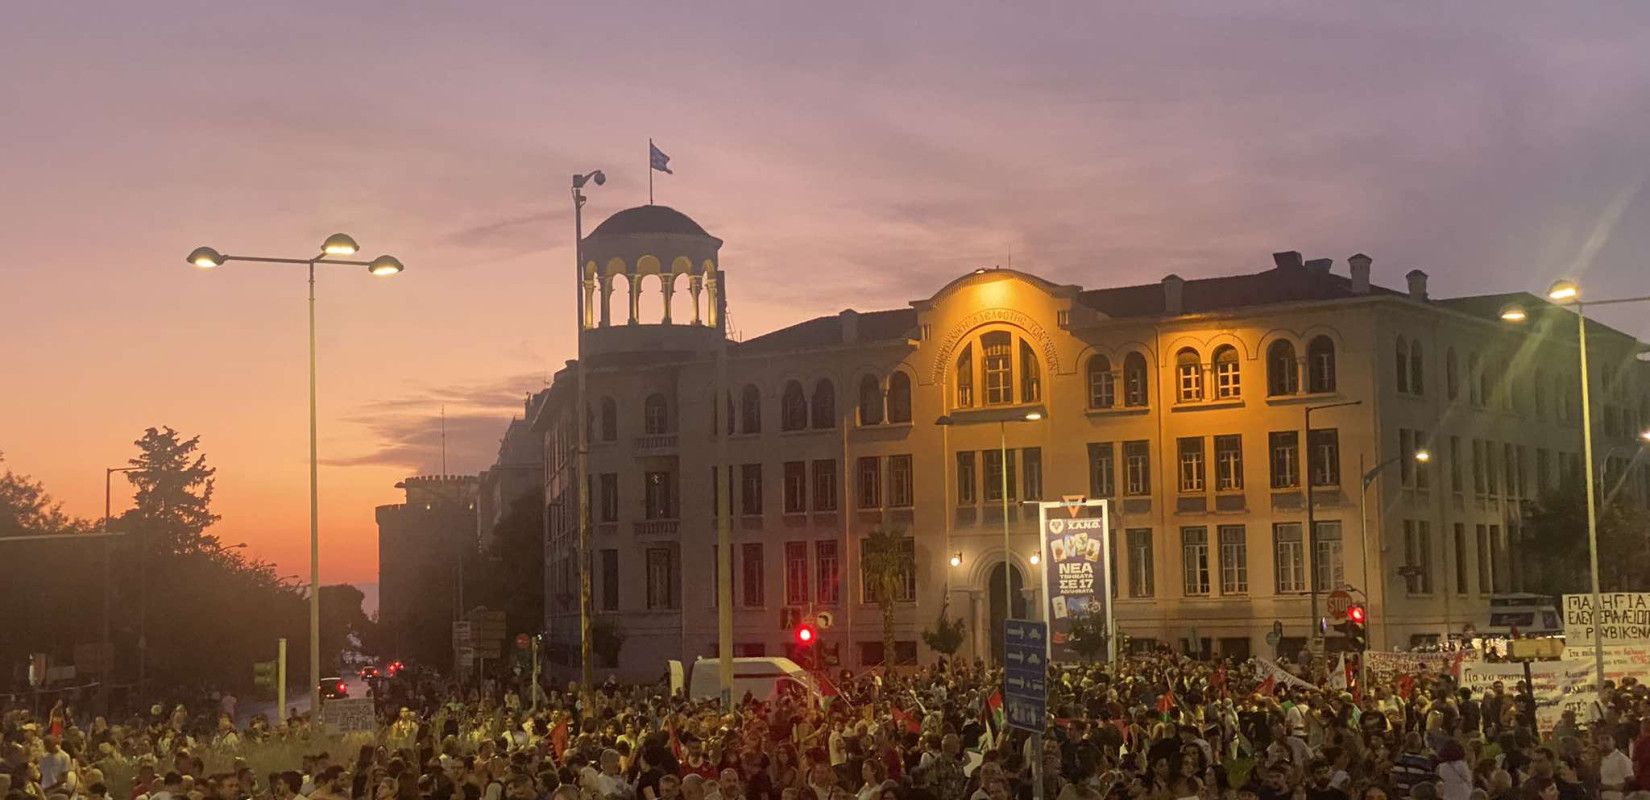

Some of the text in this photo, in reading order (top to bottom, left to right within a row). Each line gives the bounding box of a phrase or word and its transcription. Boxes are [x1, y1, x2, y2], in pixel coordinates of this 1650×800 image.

[1059, 563, 1093, 574] ΝΕΑ
[1060, 579, 1094, 589] ΣΕ 17
[1328, 597, 1351, 612] STOP
